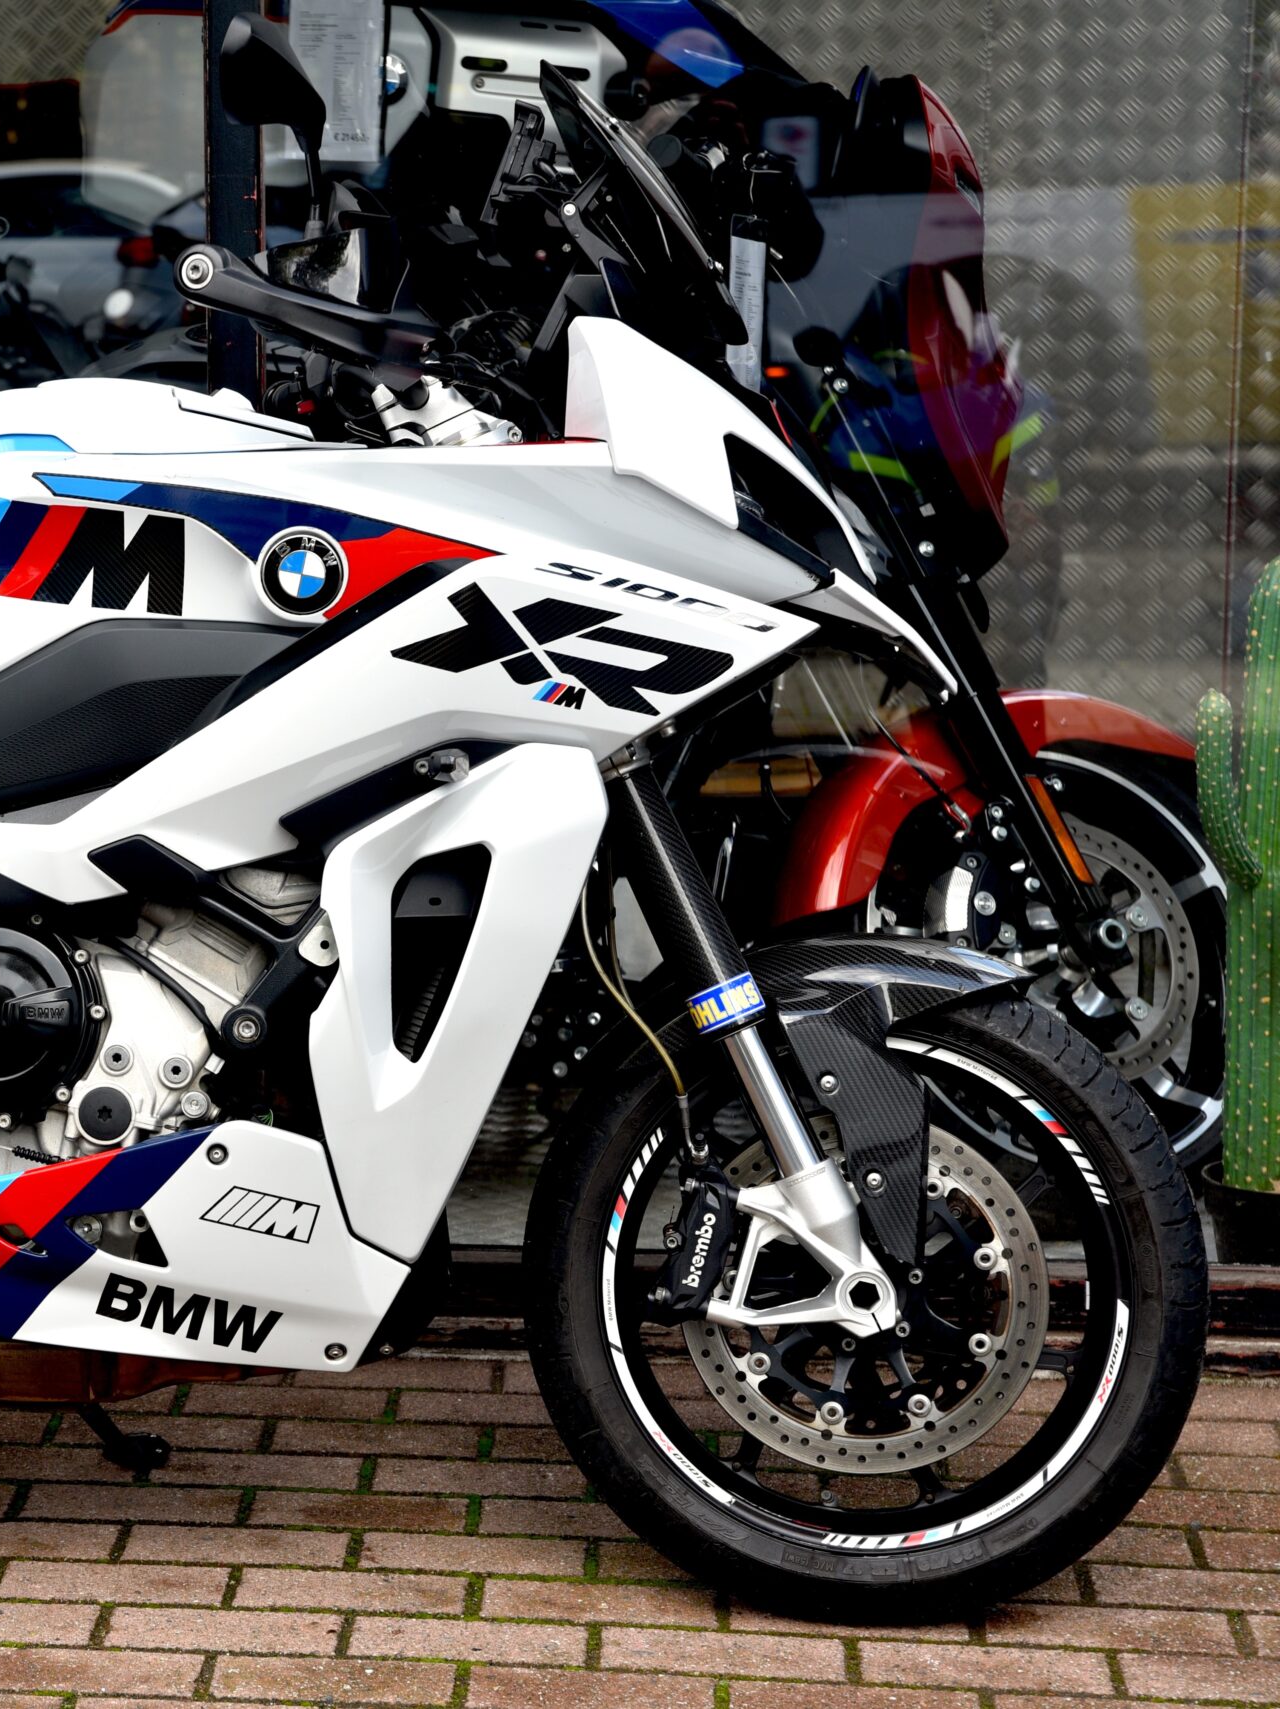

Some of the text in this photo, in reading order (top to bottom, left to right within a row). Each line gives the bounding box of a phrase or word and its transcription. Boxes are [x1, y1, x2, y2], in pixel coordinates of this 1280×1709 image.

[275, 536, 338, 567] BMW
[390, 581, 734, 716] XR
[26, 1007, 64, 1019] BMW
[681, 1212, 717, 1288] brembo
[96, 1272, 284, 1353] BMW
